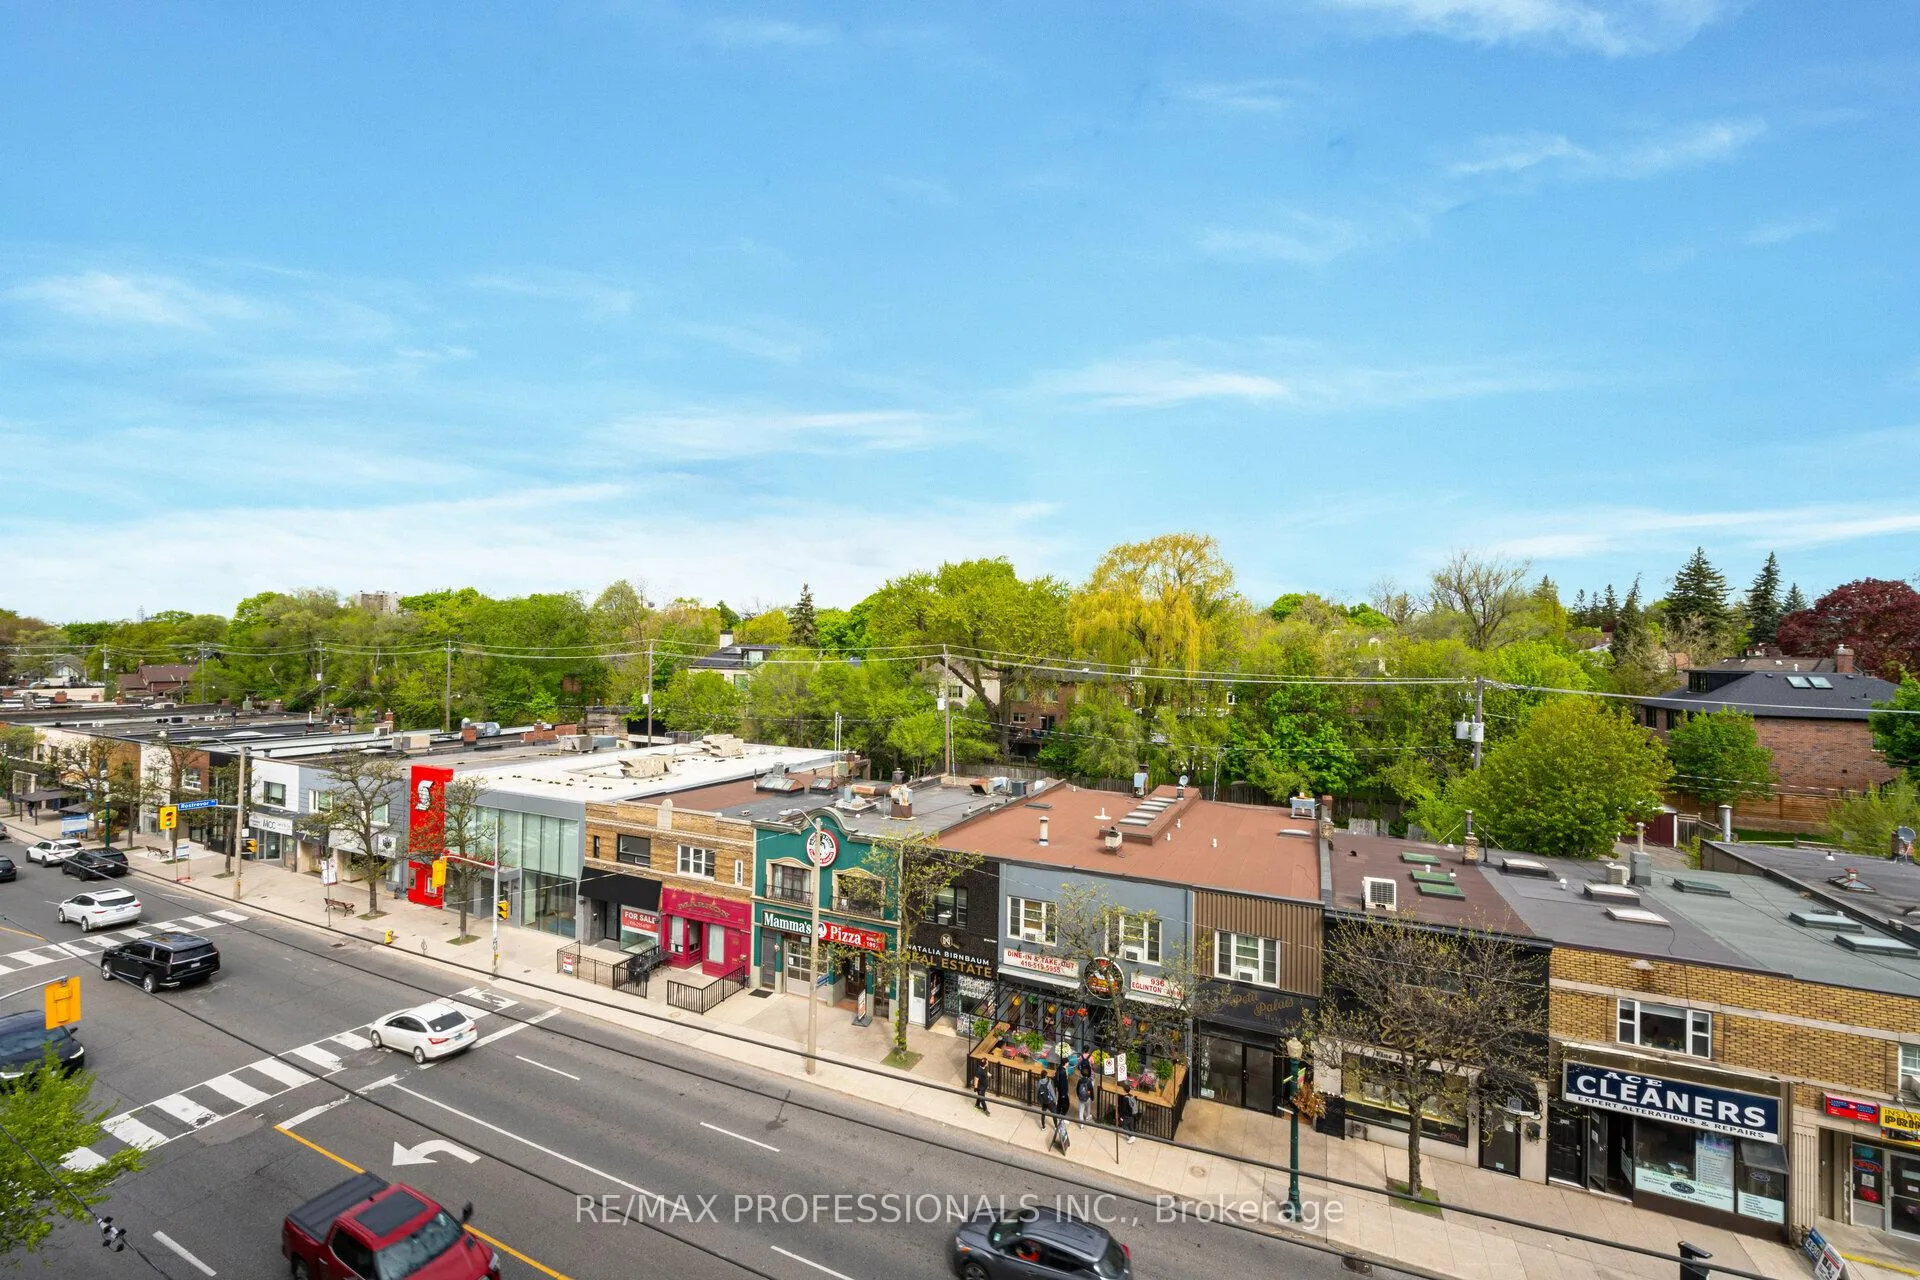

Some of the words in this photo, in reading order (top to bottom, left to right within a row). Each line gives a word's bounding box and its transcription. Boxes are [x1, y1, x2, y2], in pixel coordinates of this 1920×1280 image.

[180, 801, 209, 809] Rostrevor
[624, 911, 638, 920] FOR
[638, 914, 657, 925] SALE
[764, 912, 812, 935] Mamma's
[830, 925, 862, 945] Pizza
[903, 950, 937, 967] EAL
[941, 958, 993, 978] ESTATE
[906, 944, 941, 956] NATALIA
[944, 951, 990, 966] BIRNBAUM
[1131, 981, 1162, 993] EGLINTON
[1150, 978, 1165, 987] 936
[1254, 997, 1294, 1017] Palais
[1603, 1071, 1663, 1087] ACE
[1576, 1075, 1766, 1128] CLEANERS
[1577, 1096, 1618, 1109] EXPERT
[1622, 1105, 1696, 1125] ALTERATIONS
[1700, 1120, 1710, 1128] &
[1714, 1123, 1765, 1139] REPAIRS
